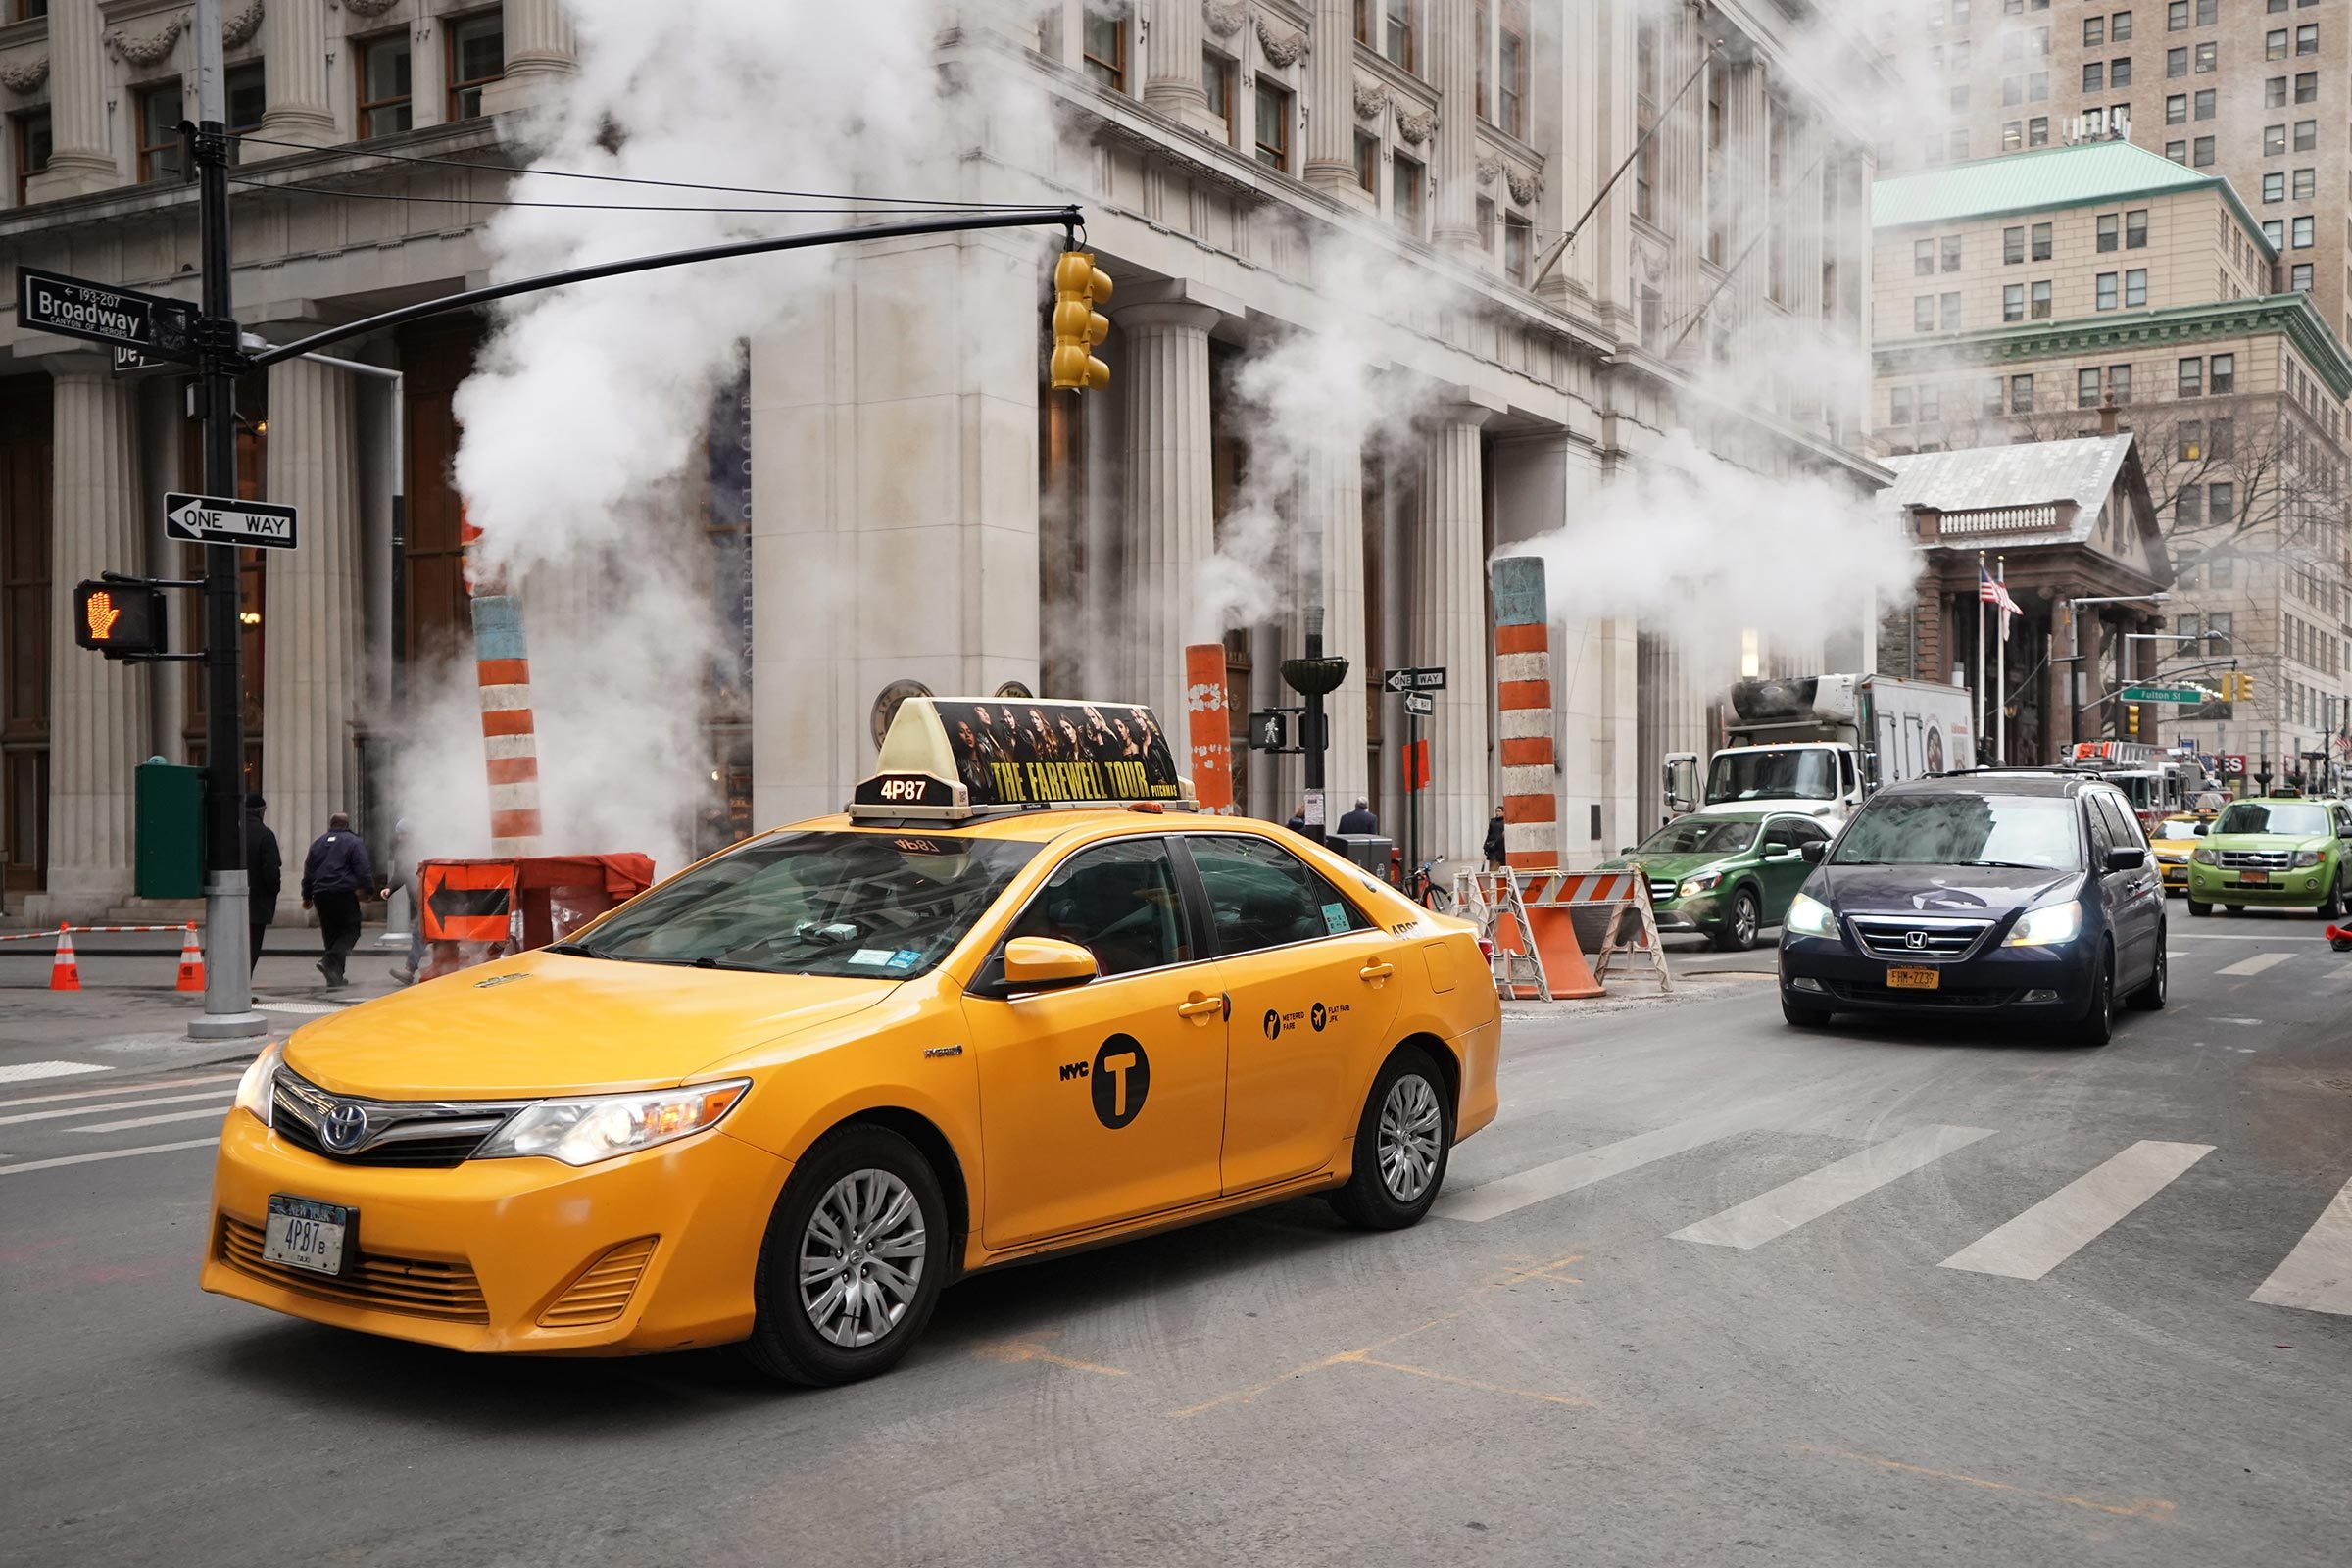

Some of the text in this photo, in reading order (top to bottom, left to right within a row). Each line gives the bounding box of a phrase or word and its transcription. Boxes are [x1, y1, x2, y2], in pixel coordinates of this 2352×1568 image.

[79, 288, 120, 308] 193-207
[39, 291, 139, 337] Broadway
[50, 317, 81, 329] CANYON
[100, 326, 127, 338] HEROES
[184, 510, 285, 534] ONE WAY
[1394, 674, 1439, 686] ONE WAY
[2141, 691, 2169, 700] Fulton
[881, 780, 926, 801] 4P87
[990, 761, 1150, 802] THE FAREWELL TOUR
[1282, 1011, 1304, 1022] METERED
[1328, 1005, 1339, 1014] FLAT
[1283, 1022, 1296, 1031] FARE
[1059, 1051, 1136, 1117] NYC T
[284, 1219, 325, 1254] 4P87 B
